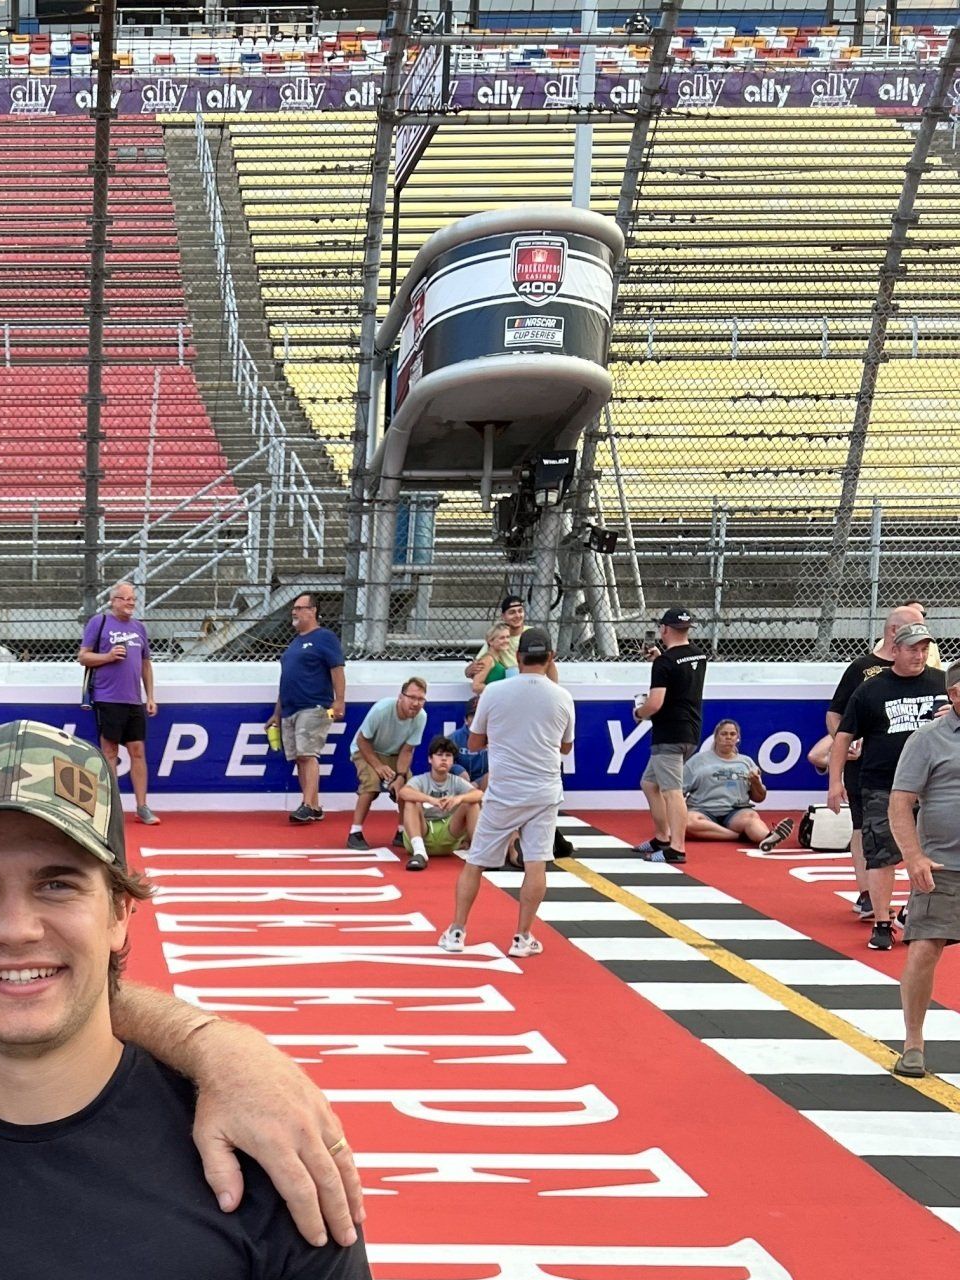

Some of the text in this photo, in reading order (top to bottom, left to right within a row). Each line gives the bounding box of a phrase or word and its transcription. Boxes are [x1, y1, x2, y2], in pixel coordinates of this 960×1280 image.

[10, 79, 56, 112] ally
[76, 84, 121, 112] aly
[141, 79, 187, 112] ally
[207, 84, 252, 112] ally
[280, 77, 326, 110] ally
[344, 82, 381, 106] all
[477, 80, 523, 109] ally
[610, 80, 641, 104] all
[677, 74, 724, 107] ally
[744, 79, 791, 107] ally
[811, 73, 858, 107] ally
[878, 78, 926, 106] ally
[519, 282, 556, 294] 400
[525, 318, 557, 328] NASCAR
[514, 331, 556, 340] CUP SERIES
[885, 703, 919, 721] DRINKER
